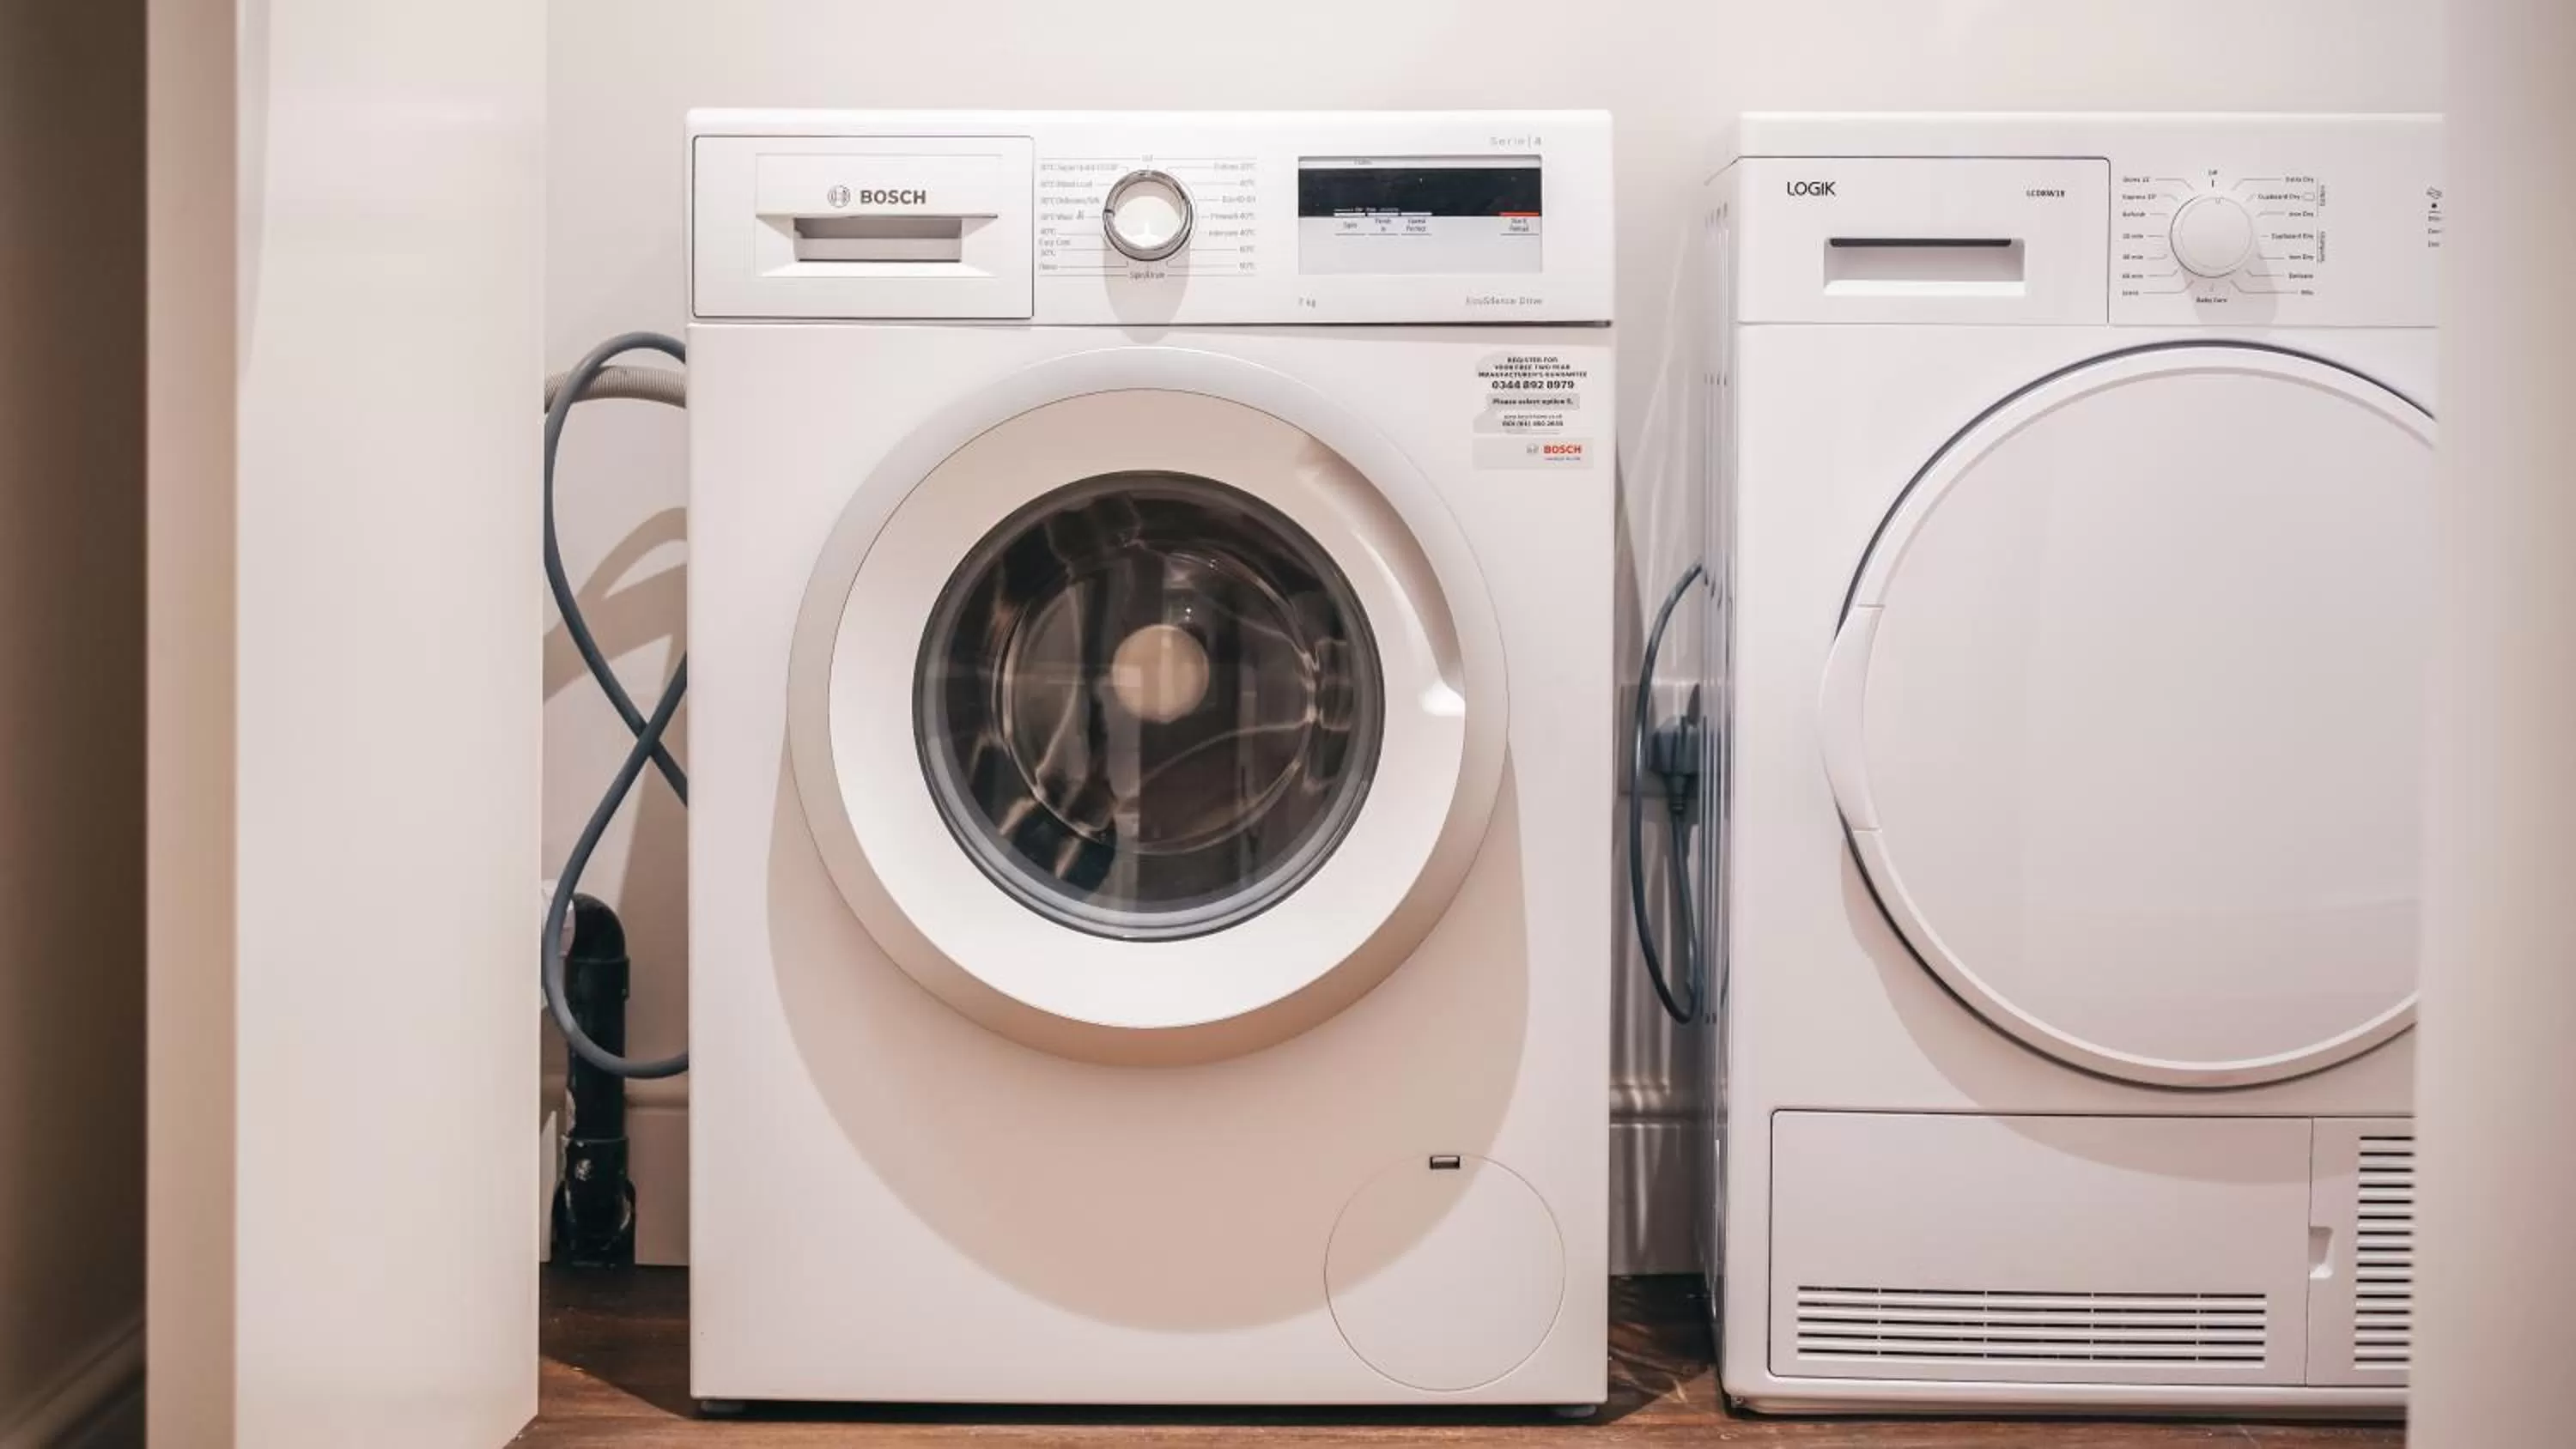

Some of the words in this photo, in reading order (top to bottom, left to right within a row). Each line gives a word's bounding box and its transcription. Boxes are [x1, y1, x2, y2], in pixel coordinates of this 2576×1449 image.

[1787, 181, 1837, 197] LOGIK
[860, 189, 927, 205] BOSCH
[1492, 380, 1521, 389] 0344
[1522, 380, 1544, 389] 892
[1546, 380, 1575, 389] 8979
[1541, 397, 1565, 406] option
[1543, 444, 1583, 453] BOSCH
